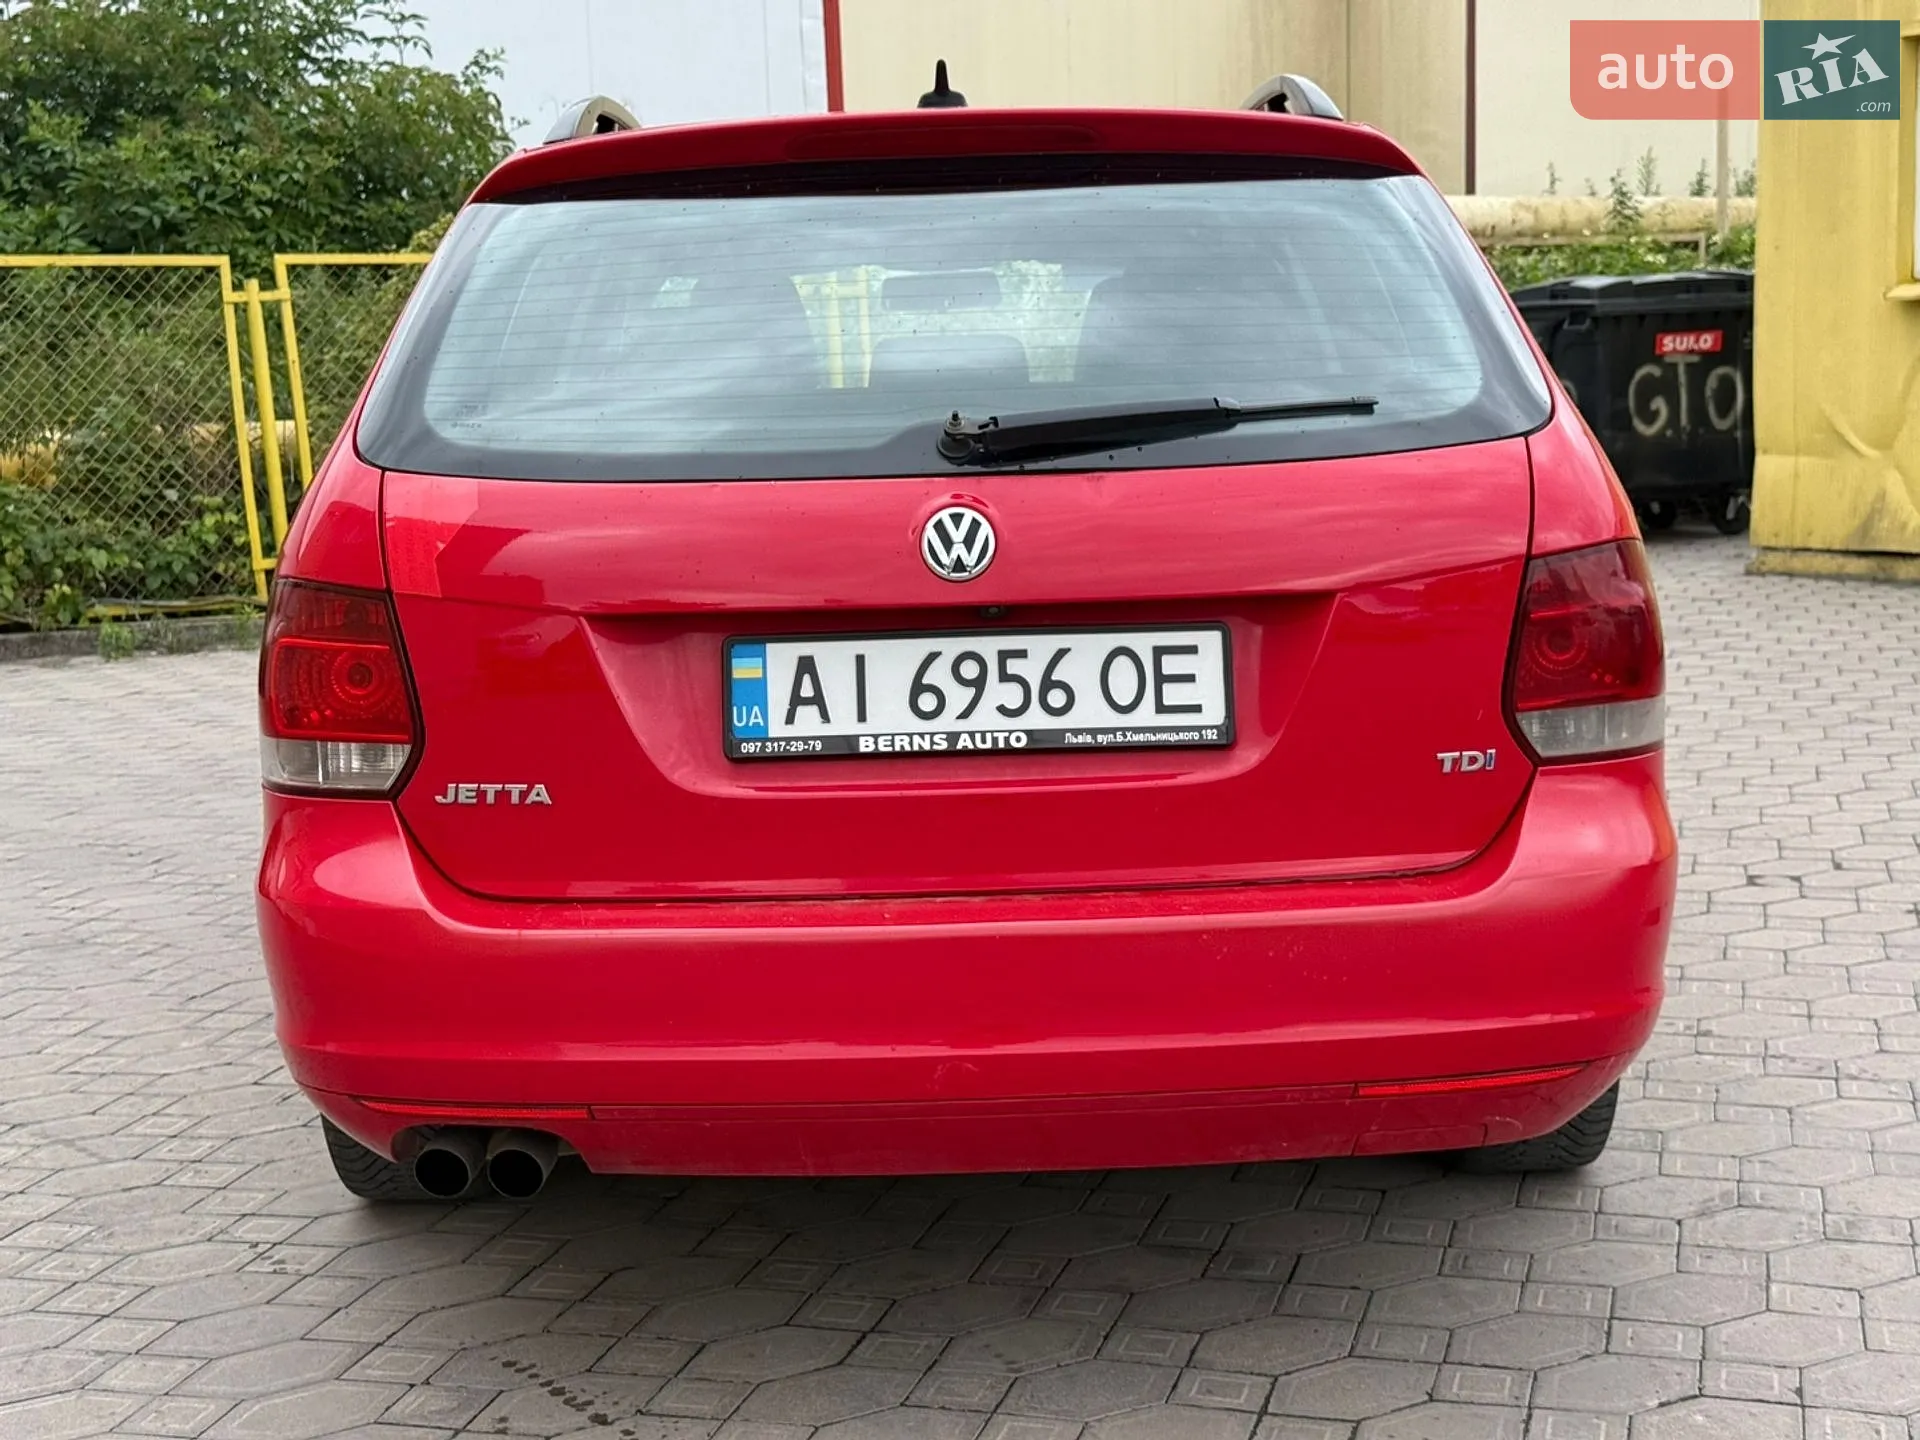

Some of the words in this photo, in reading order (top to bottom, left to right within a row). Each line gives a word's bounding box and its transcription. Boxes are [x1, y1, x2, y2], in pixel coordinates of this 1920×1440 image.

[1662, 334, 1715, 351] SULO
[784, 653, 868, 725] AI
[908, 647, 1076, 720] 6956
[1100, 644, 1203, 715] OE
[733, 705, 764, 727] UA
[858, 734, 948, 752] BERNS
[955, 731, 1028, 750] AUTO
[1201, 728, 1218, 740] 192
[740, 742, 761, 753] 097
[765, 740, 822, 752] 317-29-79
[1436, 749, 1496, 773] TDI
[434, 783, 552, 805] JETTA
